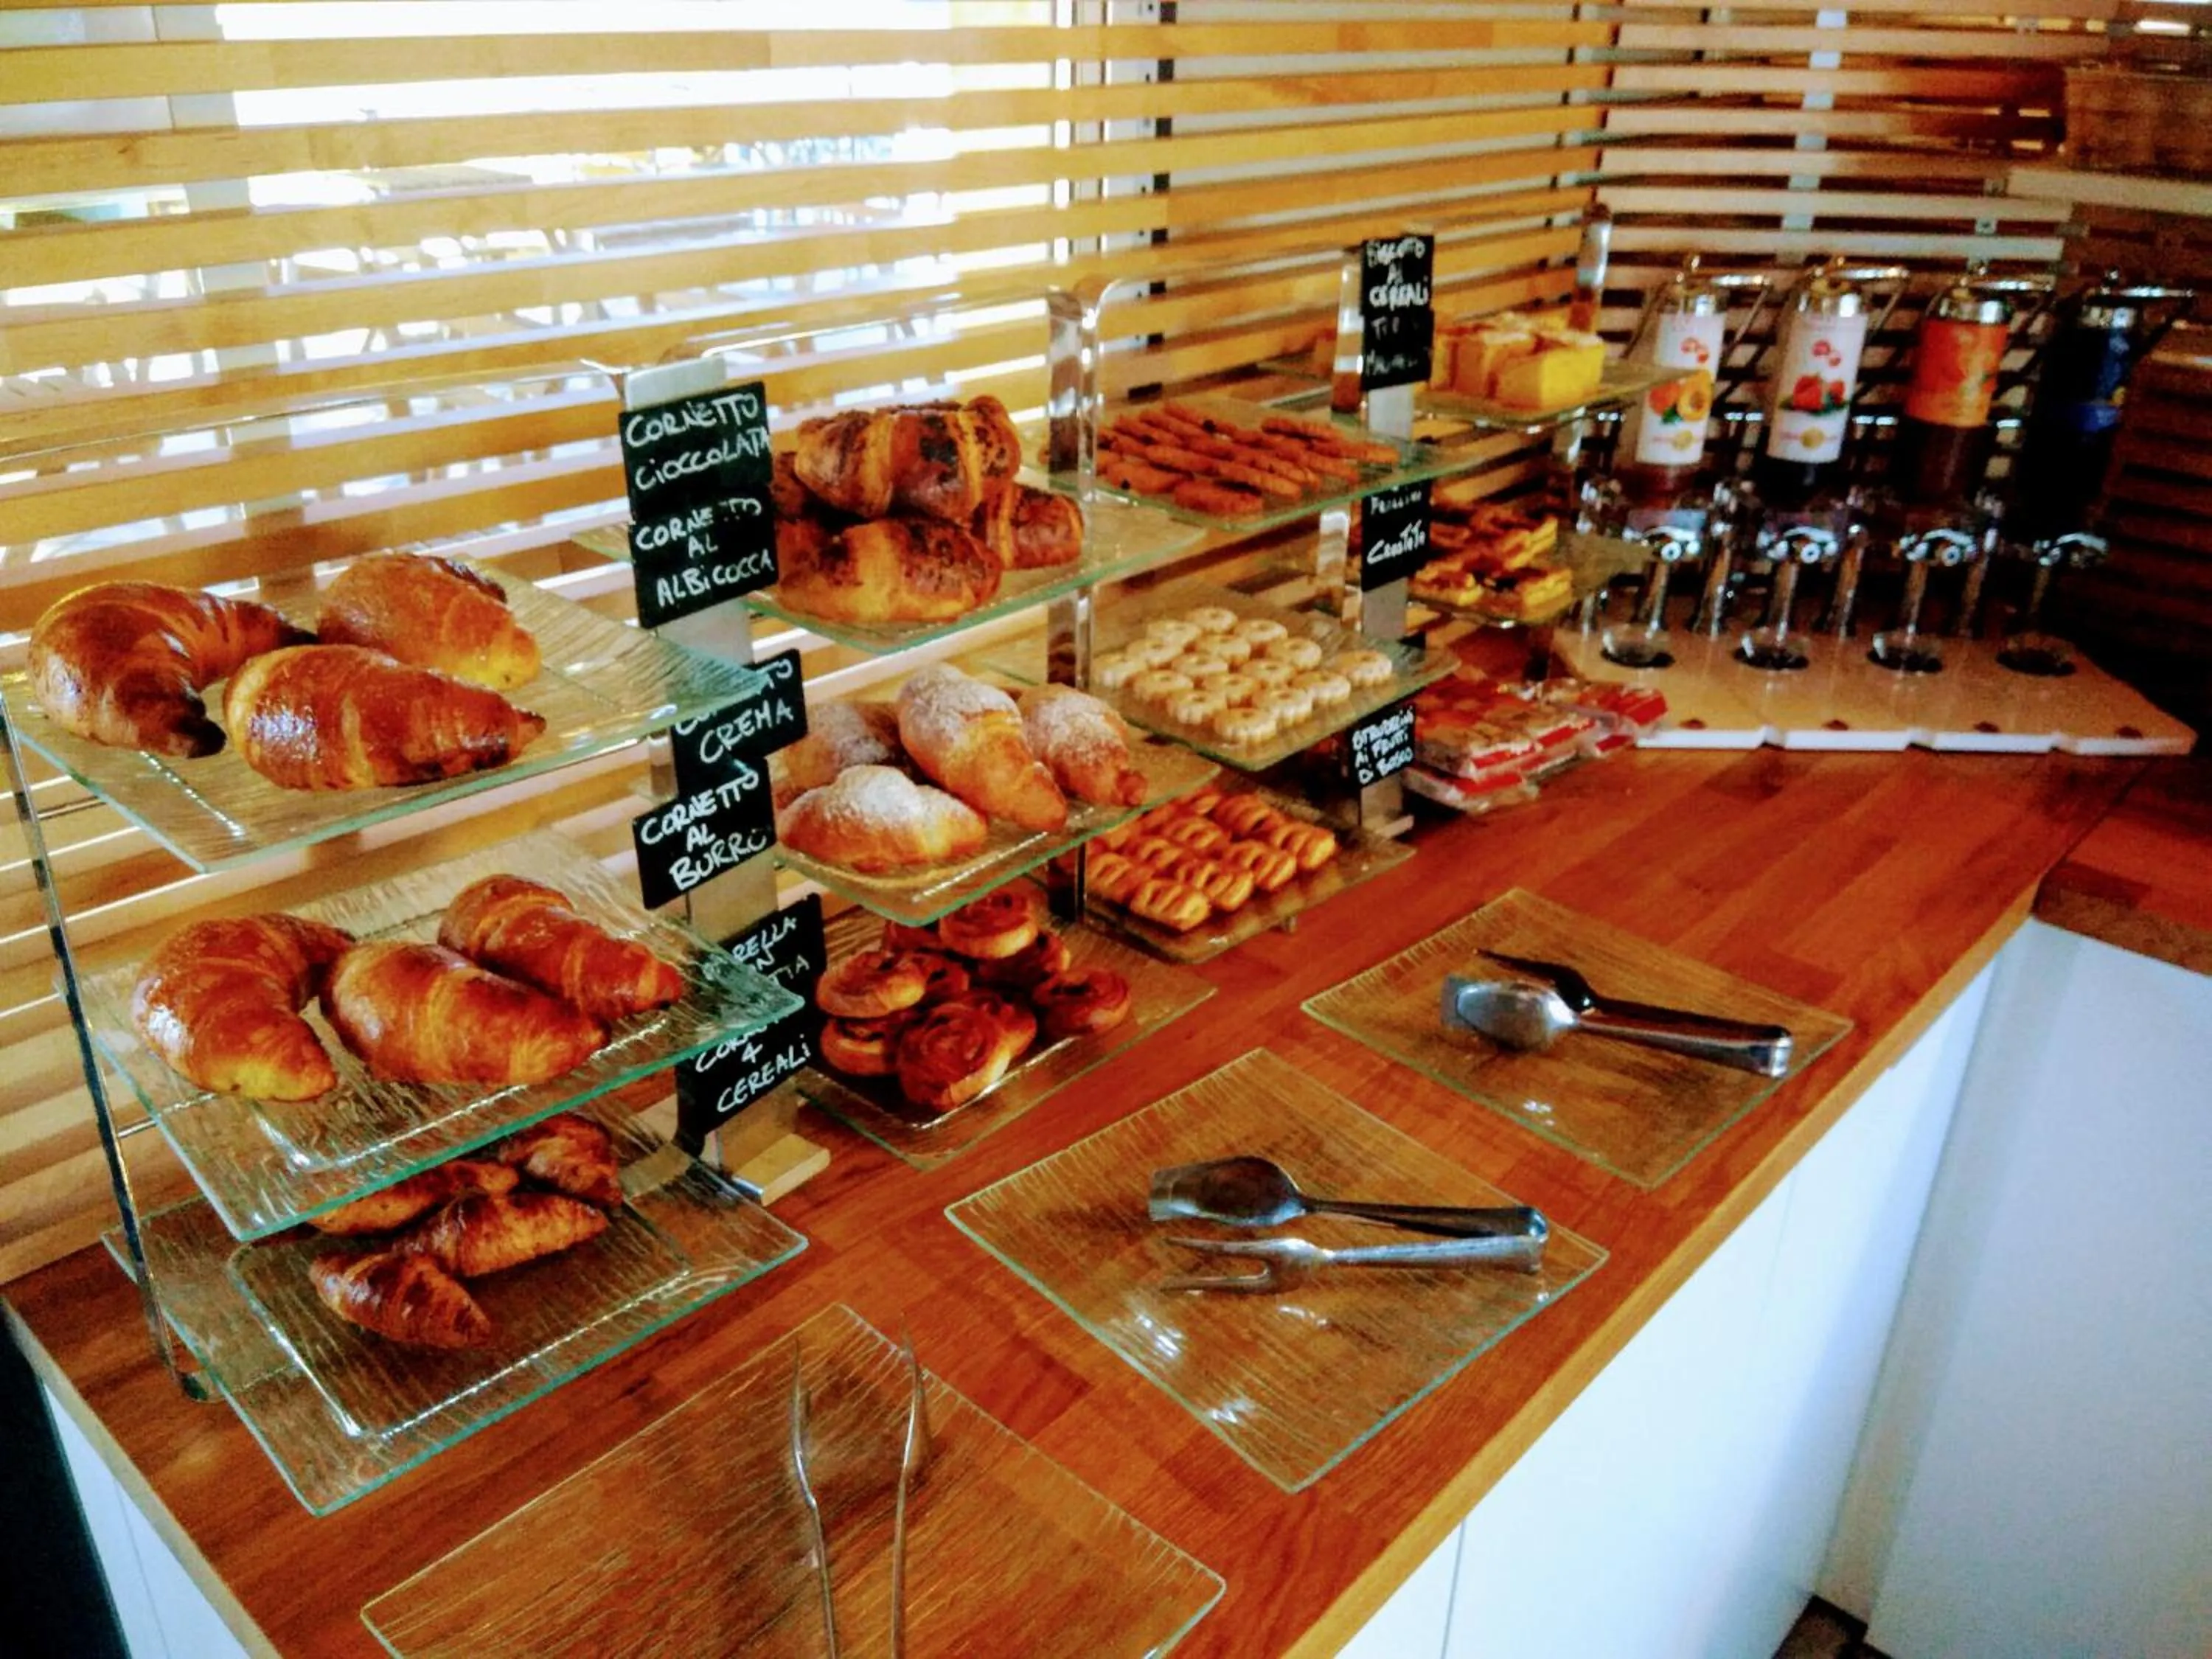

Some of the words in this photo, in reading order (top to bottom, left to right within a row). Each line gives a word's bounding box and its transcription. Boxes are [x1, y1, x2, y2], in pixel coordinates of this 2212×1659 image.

[626, 393, 758, 448] CORNETTO
[688, 533, 719, 558] AL
[700, 698, 794, 764] CREMA
[640, 771, 759, 845] CORNETTO
[669, 830, 767, 891] BURRO
[686, 823, 717, 852] AL
